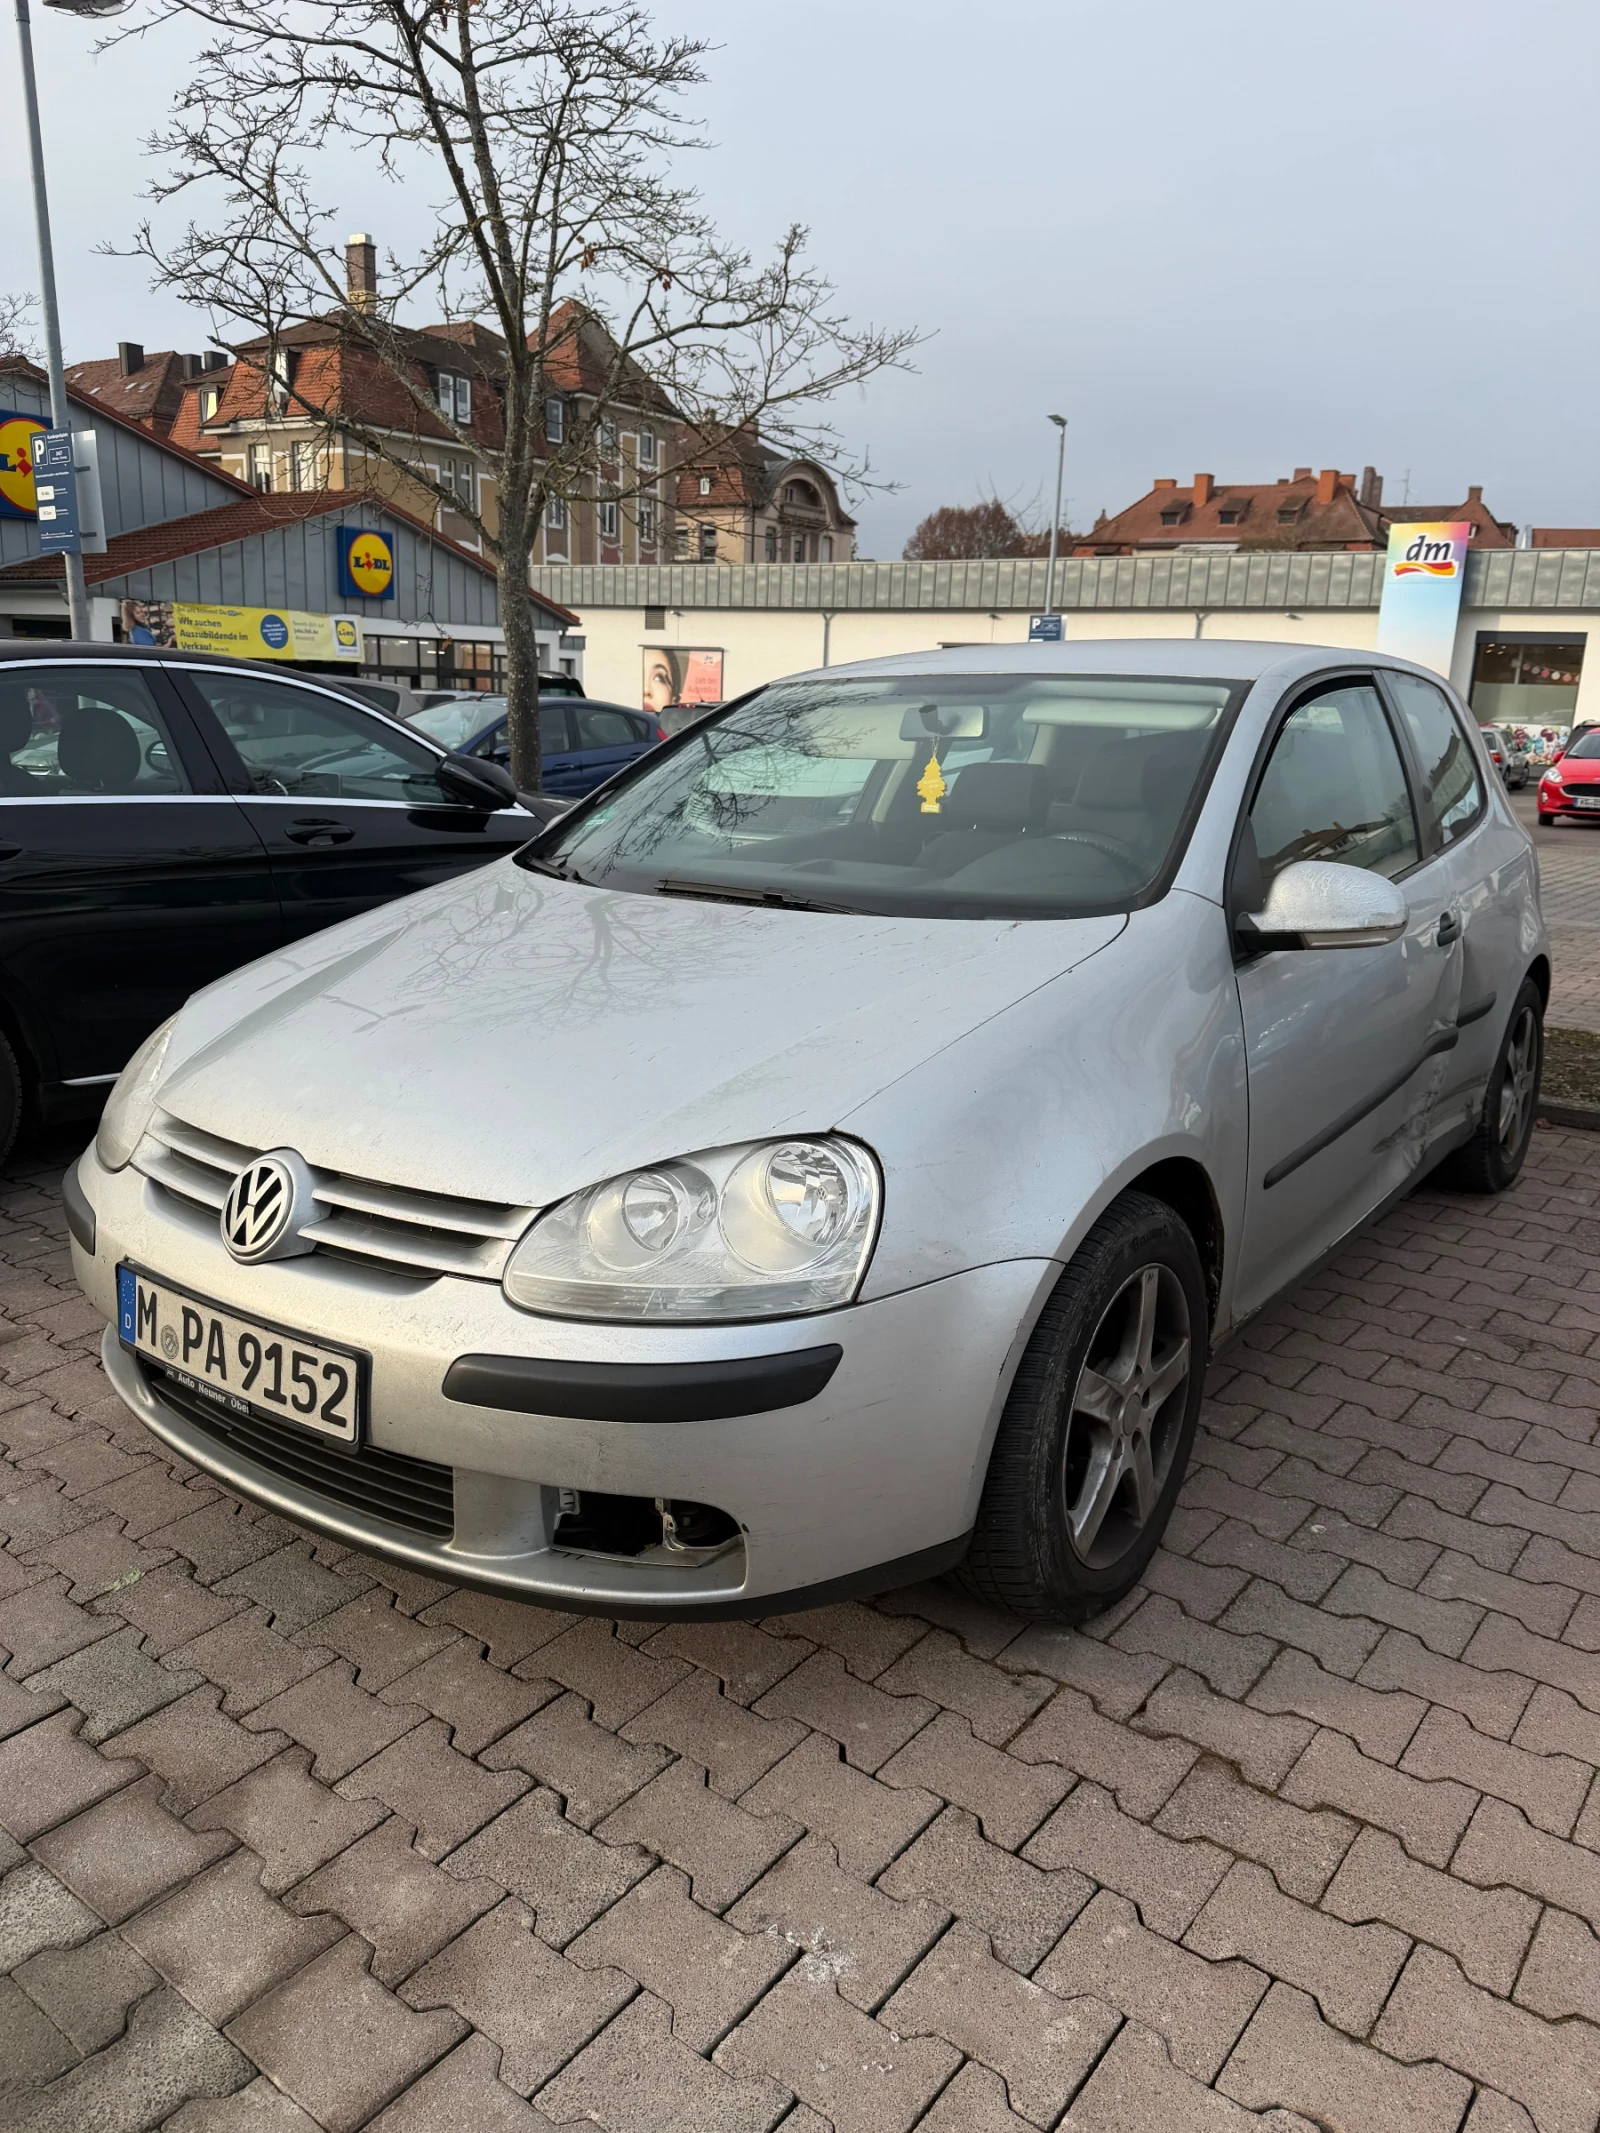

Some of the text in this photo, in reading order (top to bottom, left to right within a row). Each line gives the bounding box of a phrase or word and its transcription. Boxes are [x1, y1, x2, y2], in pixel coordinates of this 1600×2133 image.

[34, 439, 45, 463] P
[1405, 534, 1451, 562] dm
[178, 616, 222, 628] Wir suchen
[1031, 618, 1042, 630] P
[179, 629, 238, 641] Auszubildende
[238, 631, 249, 641] im
[180, 641, 212, 652] Verkauf
[124, 1312, 133, 1330] D
[137, 1284, 158, 1348] M
[181, 1304, 228, 1381] PA
[237, 1332, 349, 1429] 9152
[177, 1373, 195, 1389] Auto
[198, 1382, 226, 1405] Neuner
